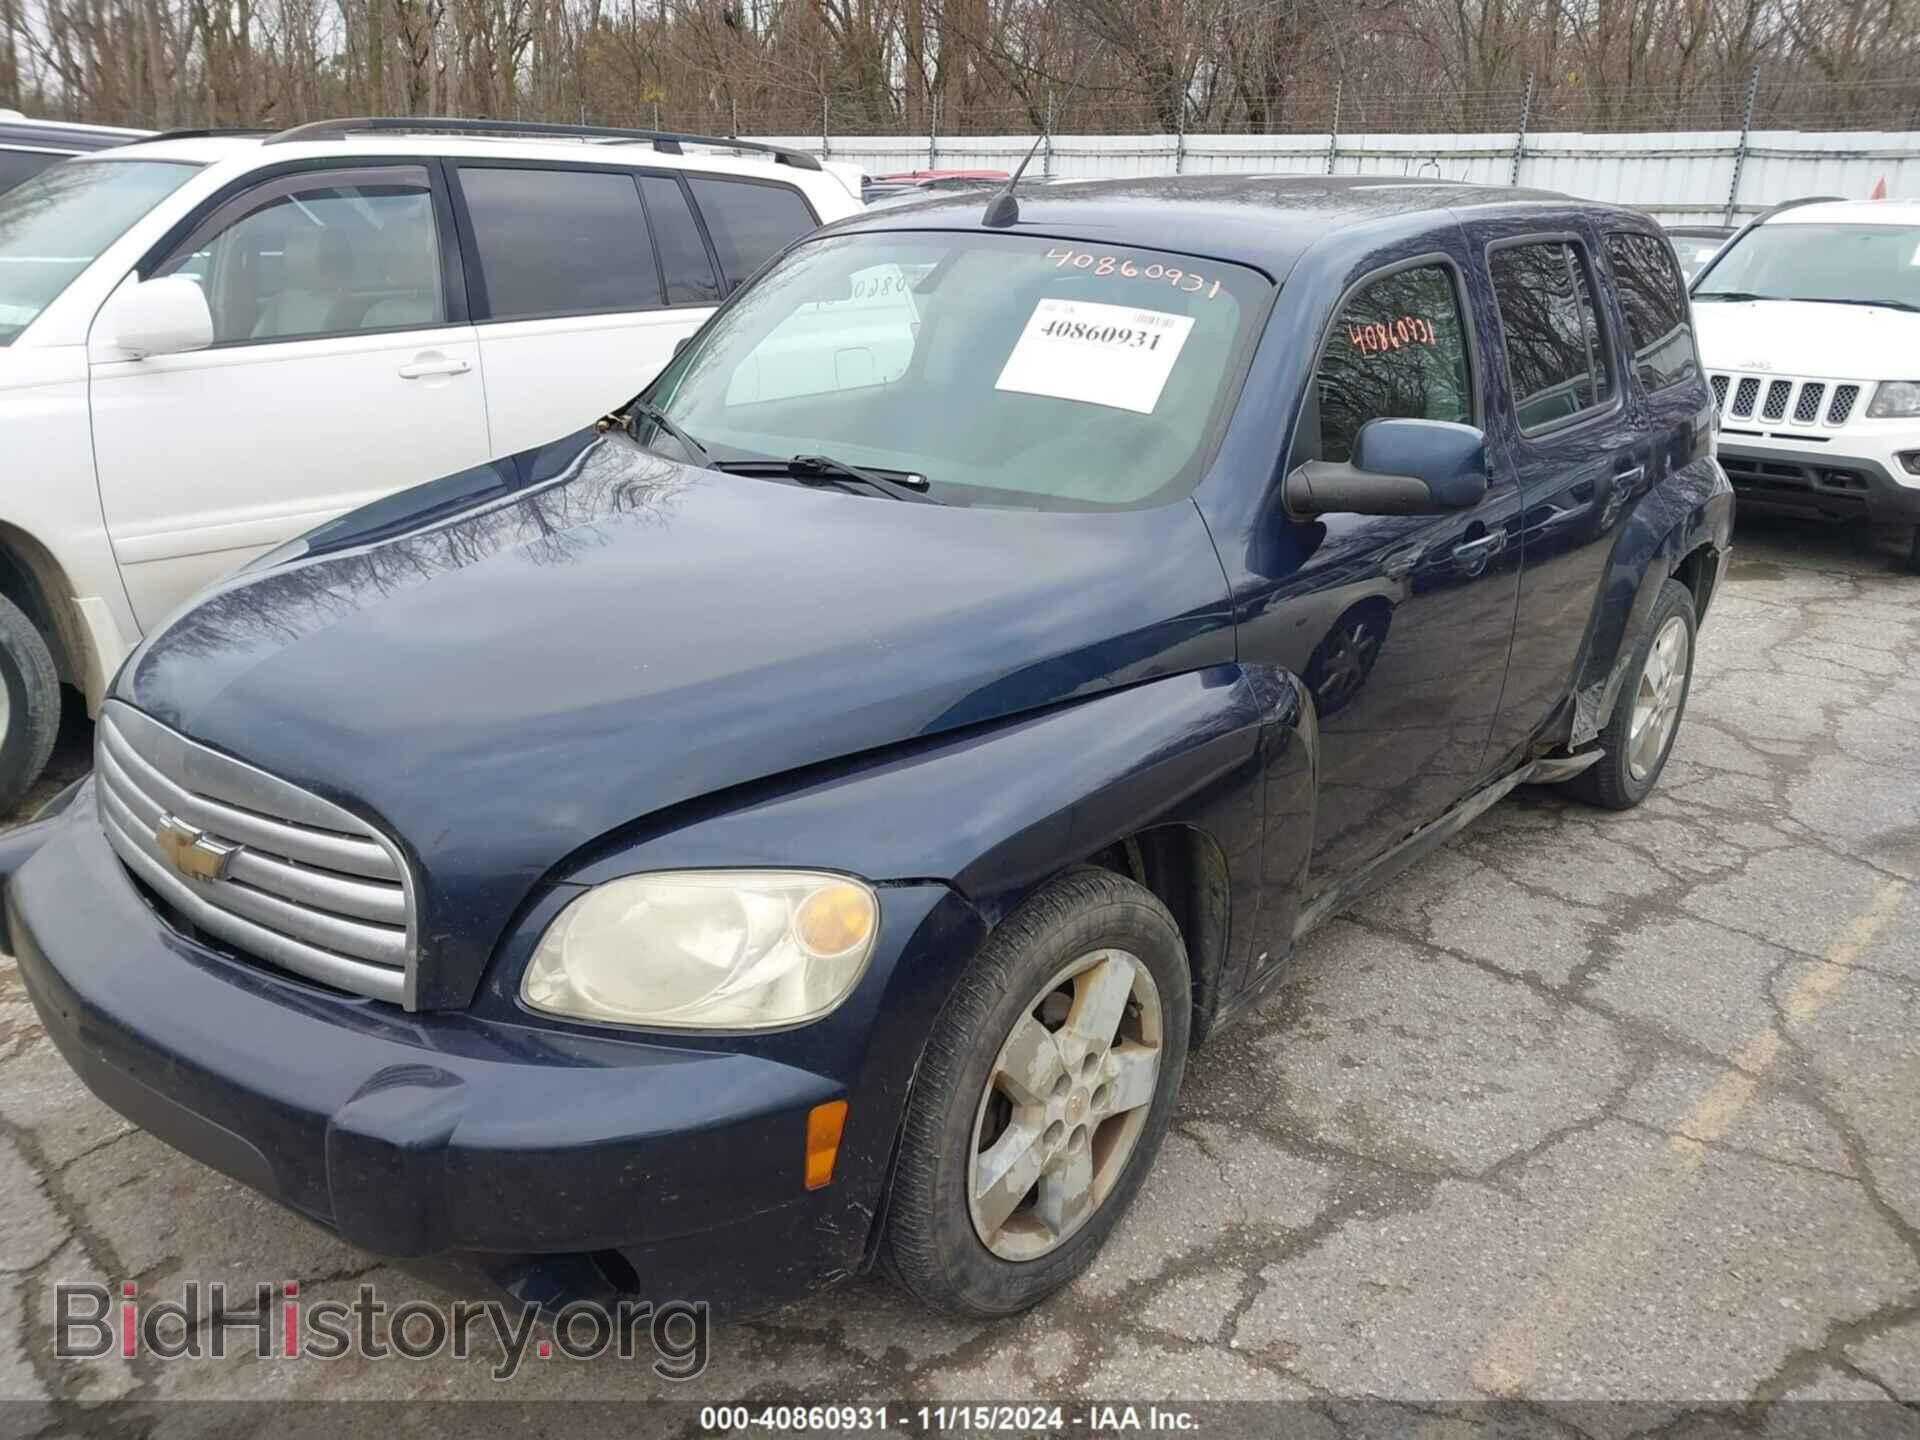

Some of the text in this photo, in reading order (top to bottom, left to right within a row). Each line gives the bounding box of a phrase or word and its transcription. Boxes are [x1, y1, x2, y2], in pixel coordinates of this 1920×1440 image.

[1046, 249, 1220, 298] 40860931
[1041, 320, 1161, 351] 40860931
[1348, 316, 1436, 356] 40860931
